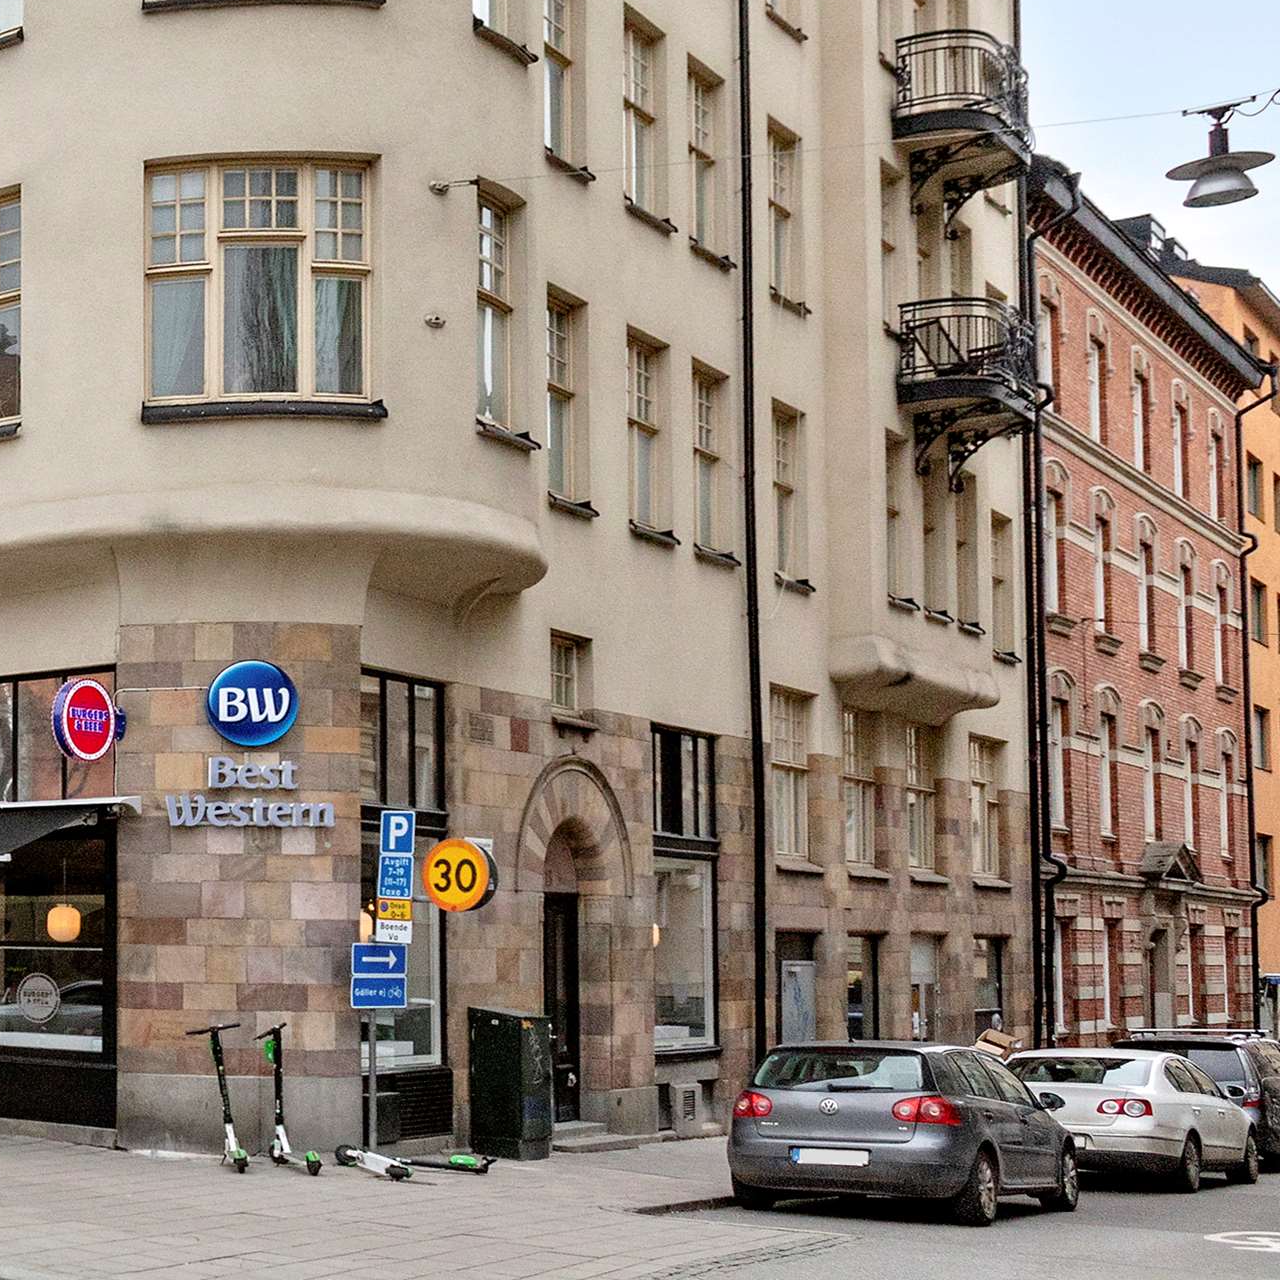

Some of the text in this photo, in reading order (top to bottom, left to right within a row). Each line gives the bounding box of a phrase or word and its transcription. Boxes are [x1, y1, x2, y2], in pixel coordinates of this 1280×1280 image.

[69, 707, 109, 722] BURGERS
[218, 687, 290, 723] BW
[82, 720, 104, 733] BEER
[208, 756, 299, 789] Best
[165, 794, 336, 828] Western
[389, 816, 409, 850] P
[384, 857, 409, 867] Avgift
[433, 858, 477, 893] 30
[380, 922, 408, 932] Boende
